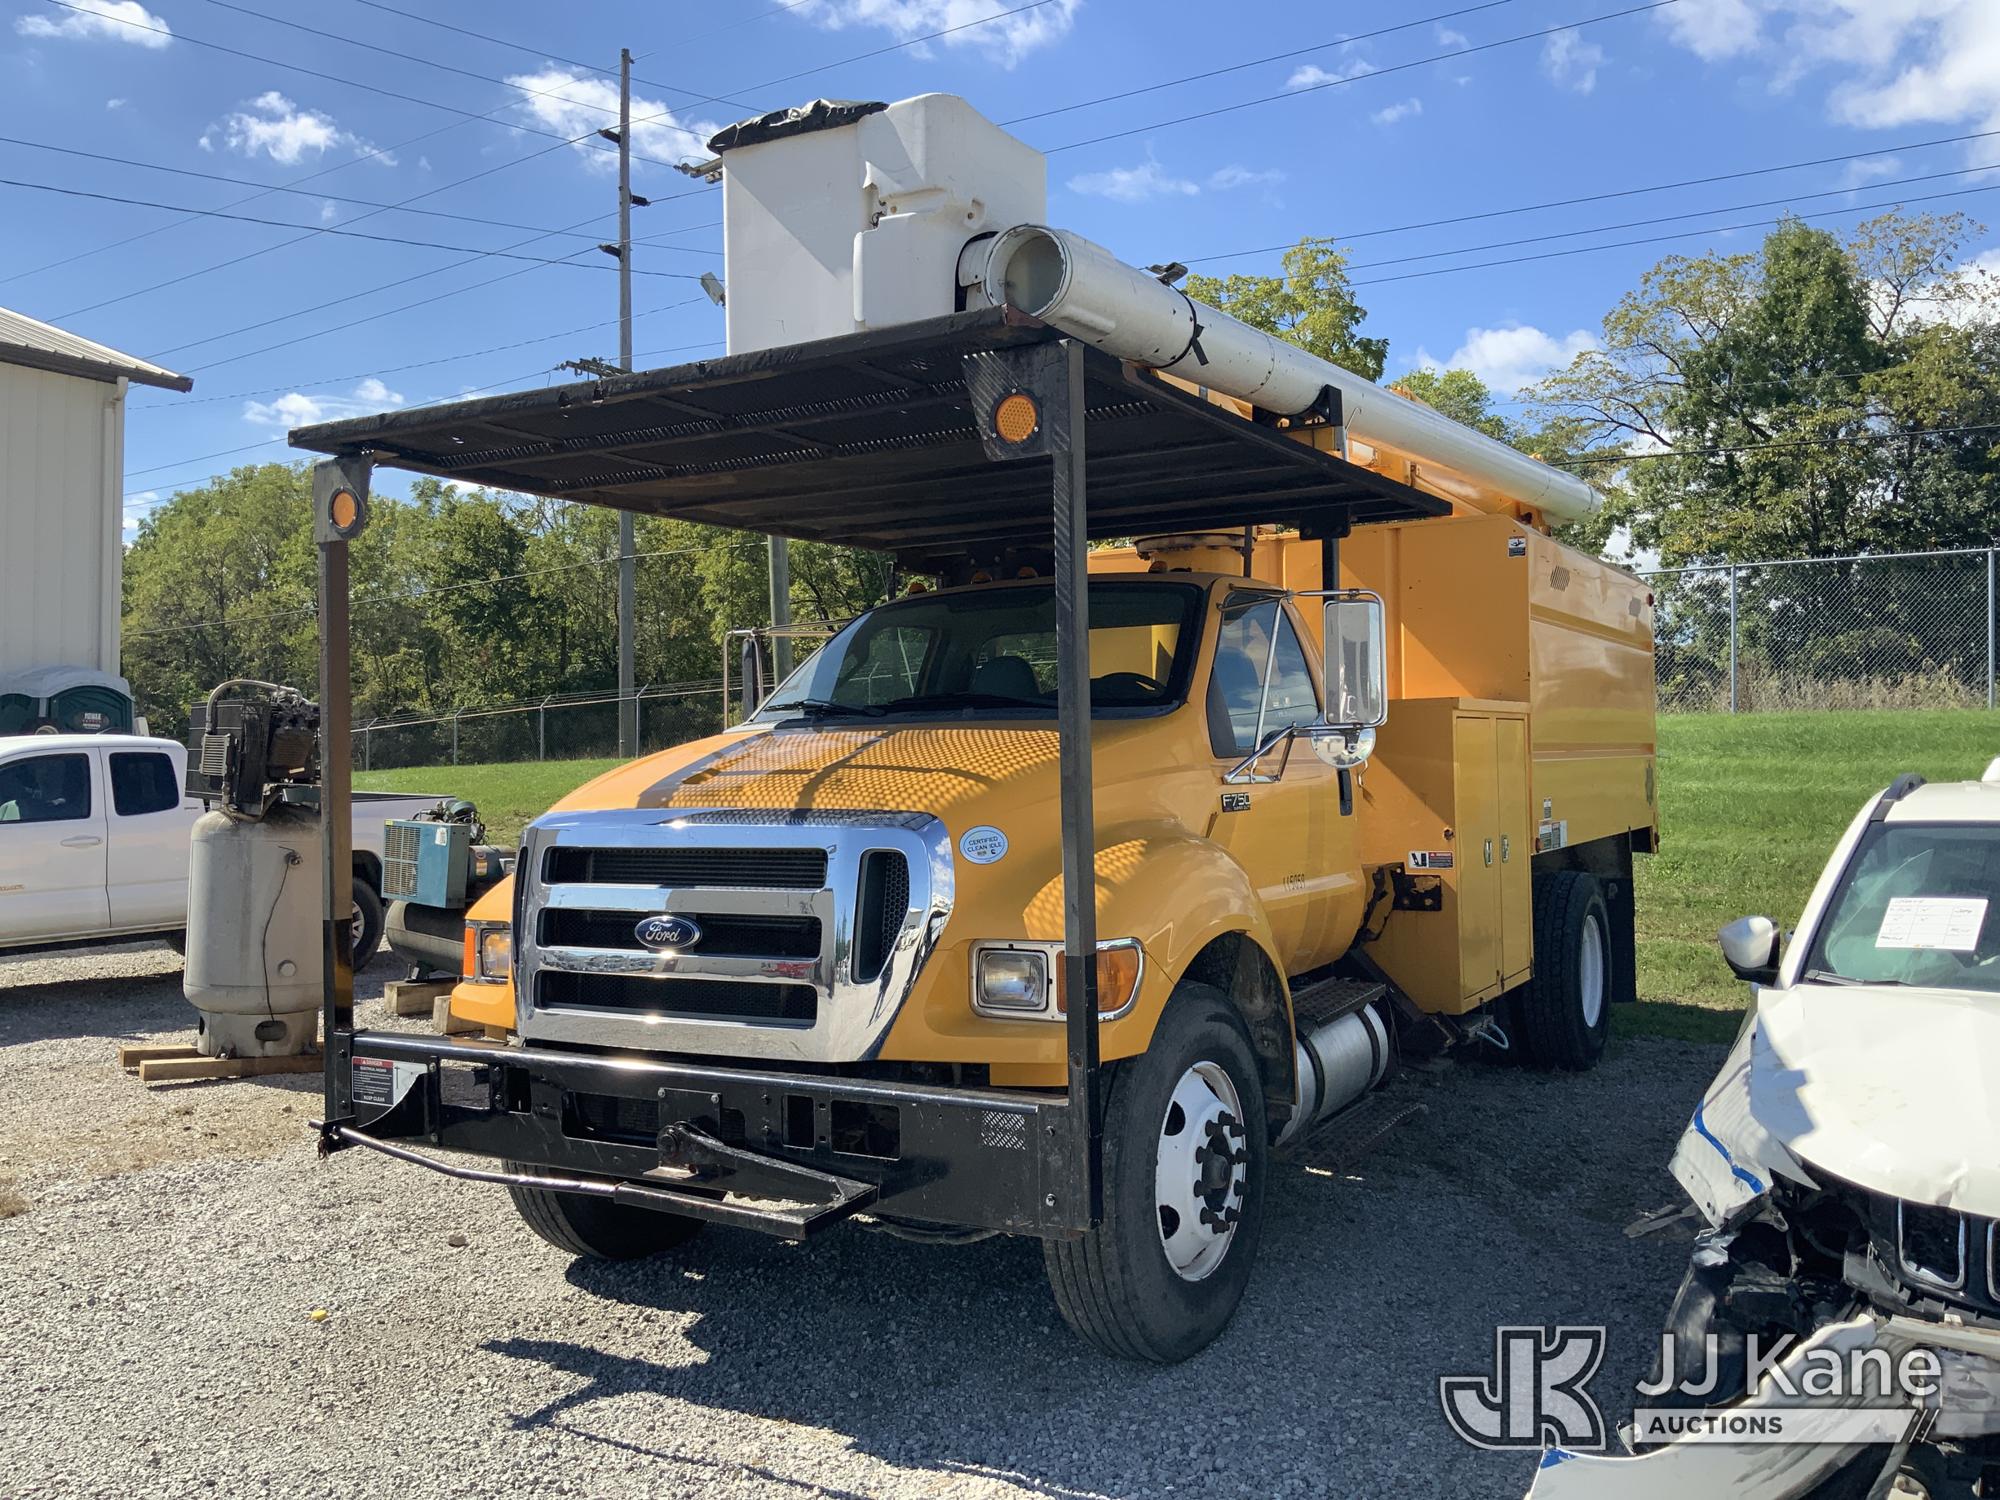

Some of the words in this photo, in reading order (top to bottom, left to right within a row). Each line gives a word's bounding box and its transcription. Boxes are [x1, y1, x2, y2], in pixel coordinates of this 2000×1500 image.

[968, 836, 999, 846] CERTIFIED
[967, 845, 988, 853] CLEAN
[645, 921, 681, 942] Ford
